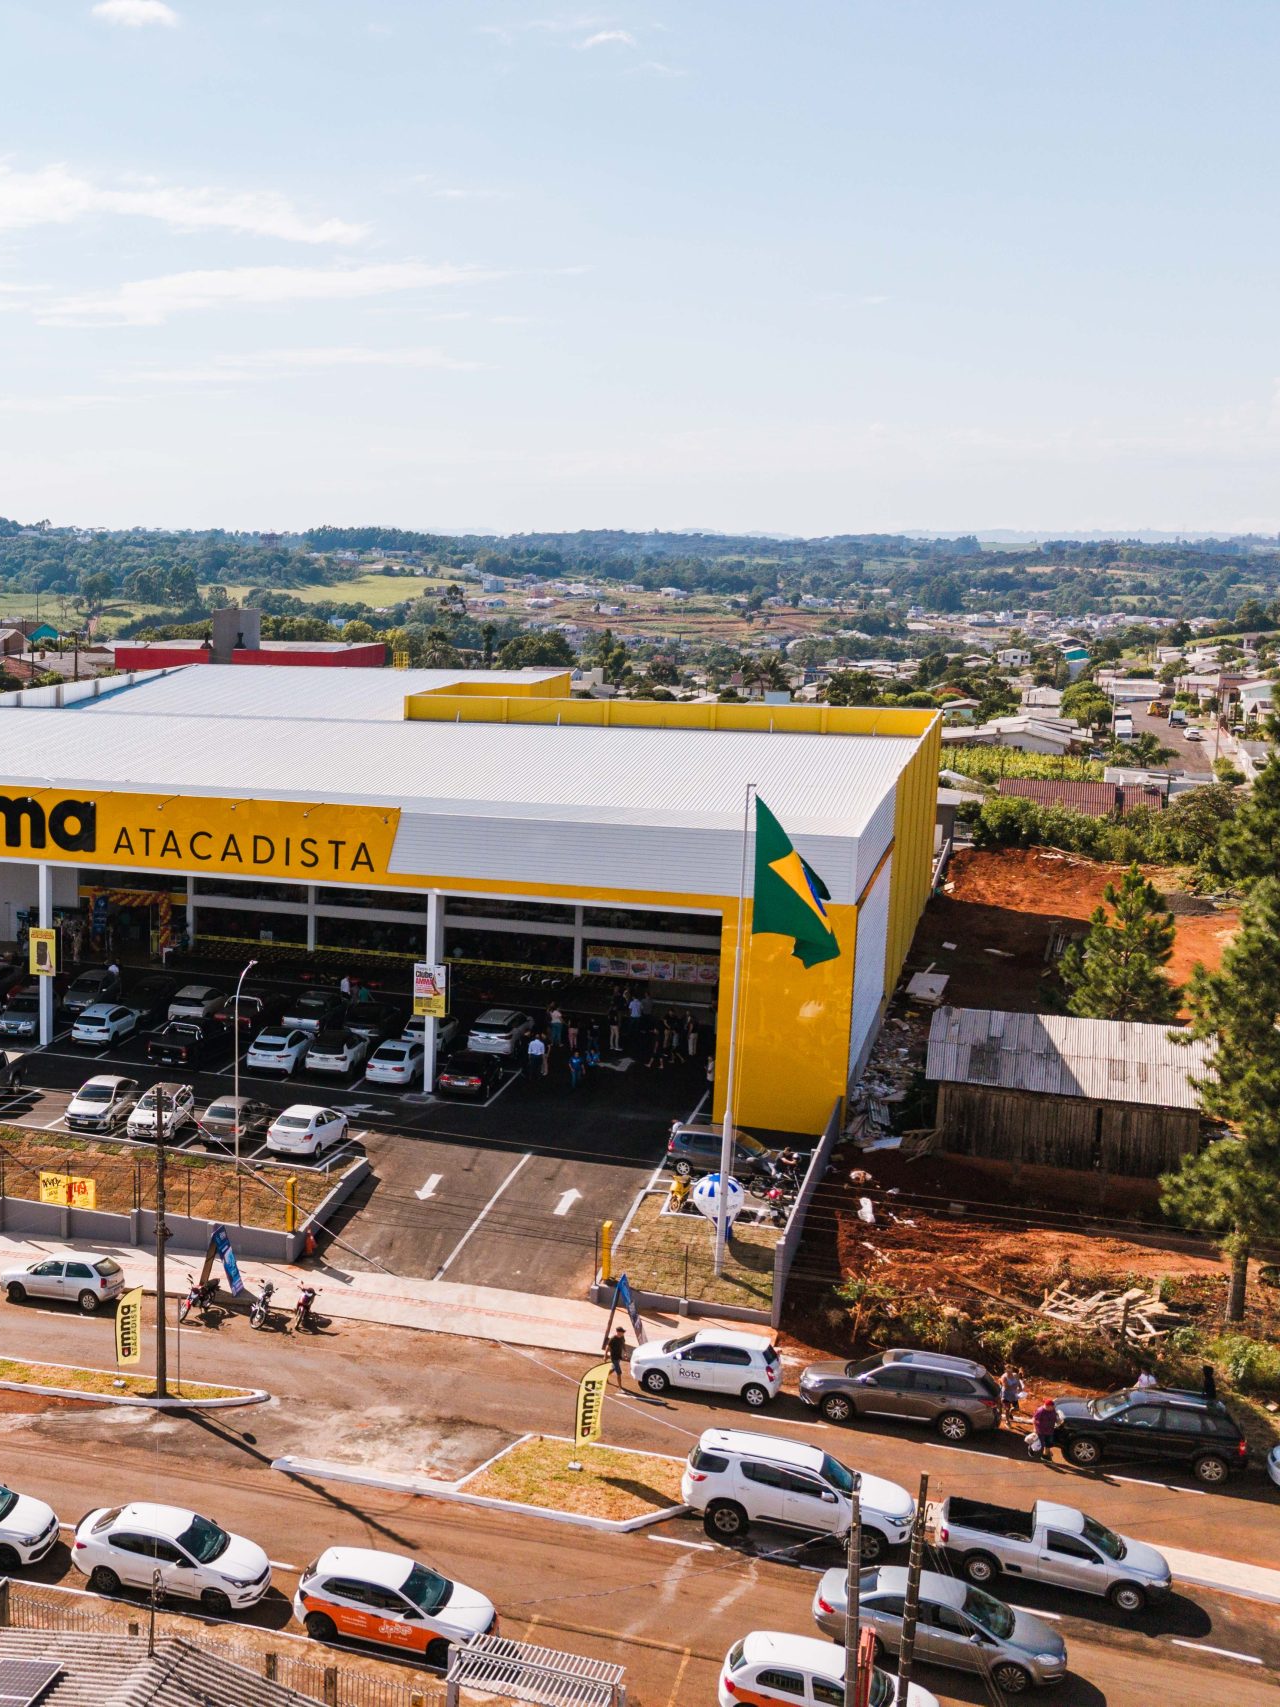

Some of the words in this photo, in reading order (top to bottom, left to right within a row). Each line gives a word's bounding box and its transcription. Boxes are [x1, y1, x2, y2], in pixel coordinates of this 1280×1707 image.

[113, 826, 375, 872] ATACADISTA
[415, 970, 433, 978] Clube
[121, 1304, 131, 1357] amma
[679, 1367, 701, 1379] Rota
[581, 1380, 596, 1437] amma
